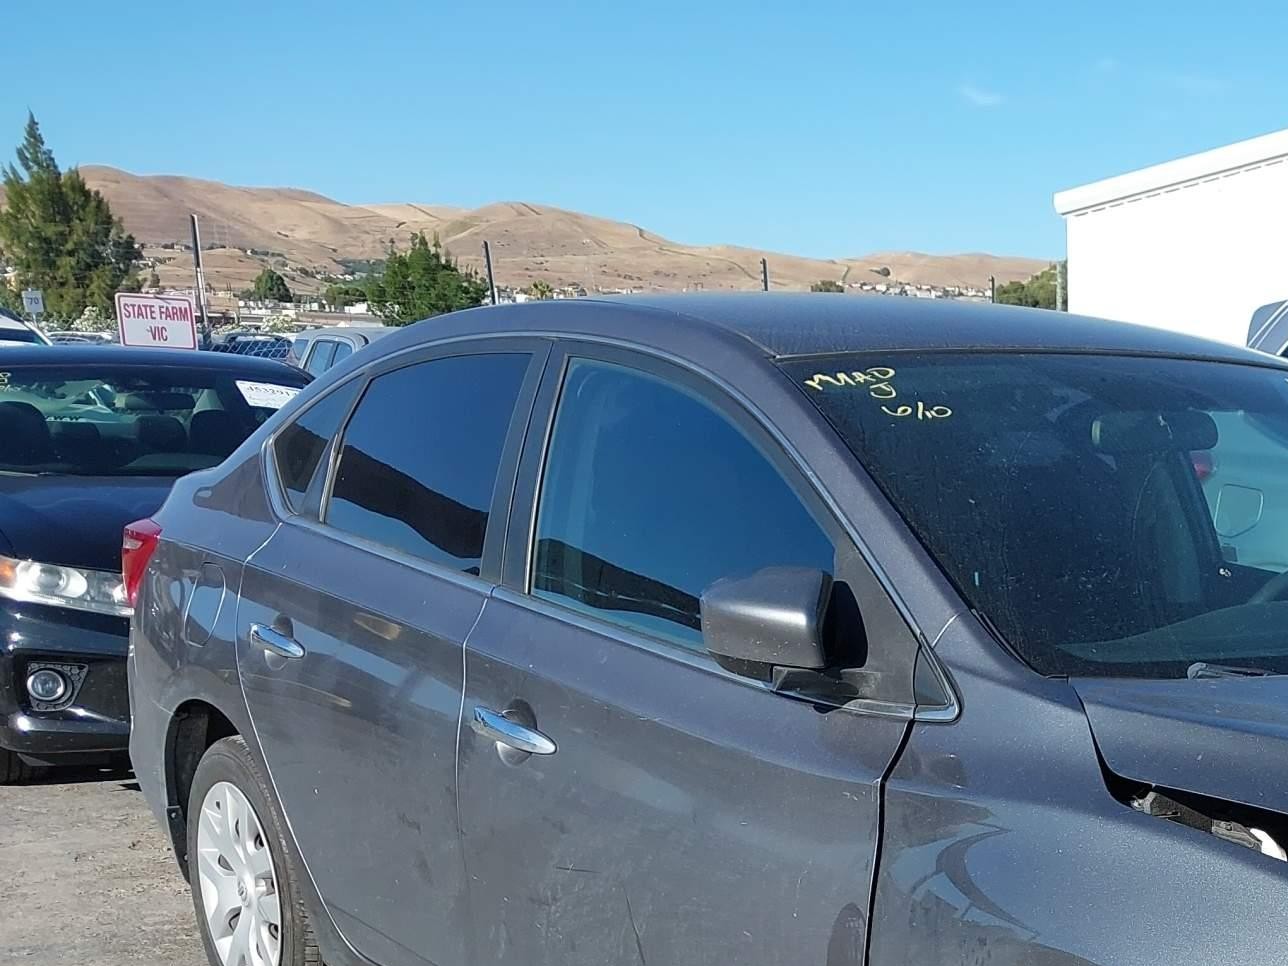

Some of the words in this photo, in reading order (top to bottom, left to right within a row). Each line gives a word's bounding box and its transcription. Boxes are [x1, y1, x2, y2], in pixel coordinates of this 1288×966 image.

[123, 303, 157, 320] STATE
[159, 304, 189, 322] FARM
[150, 326, 168, 342] VIC
